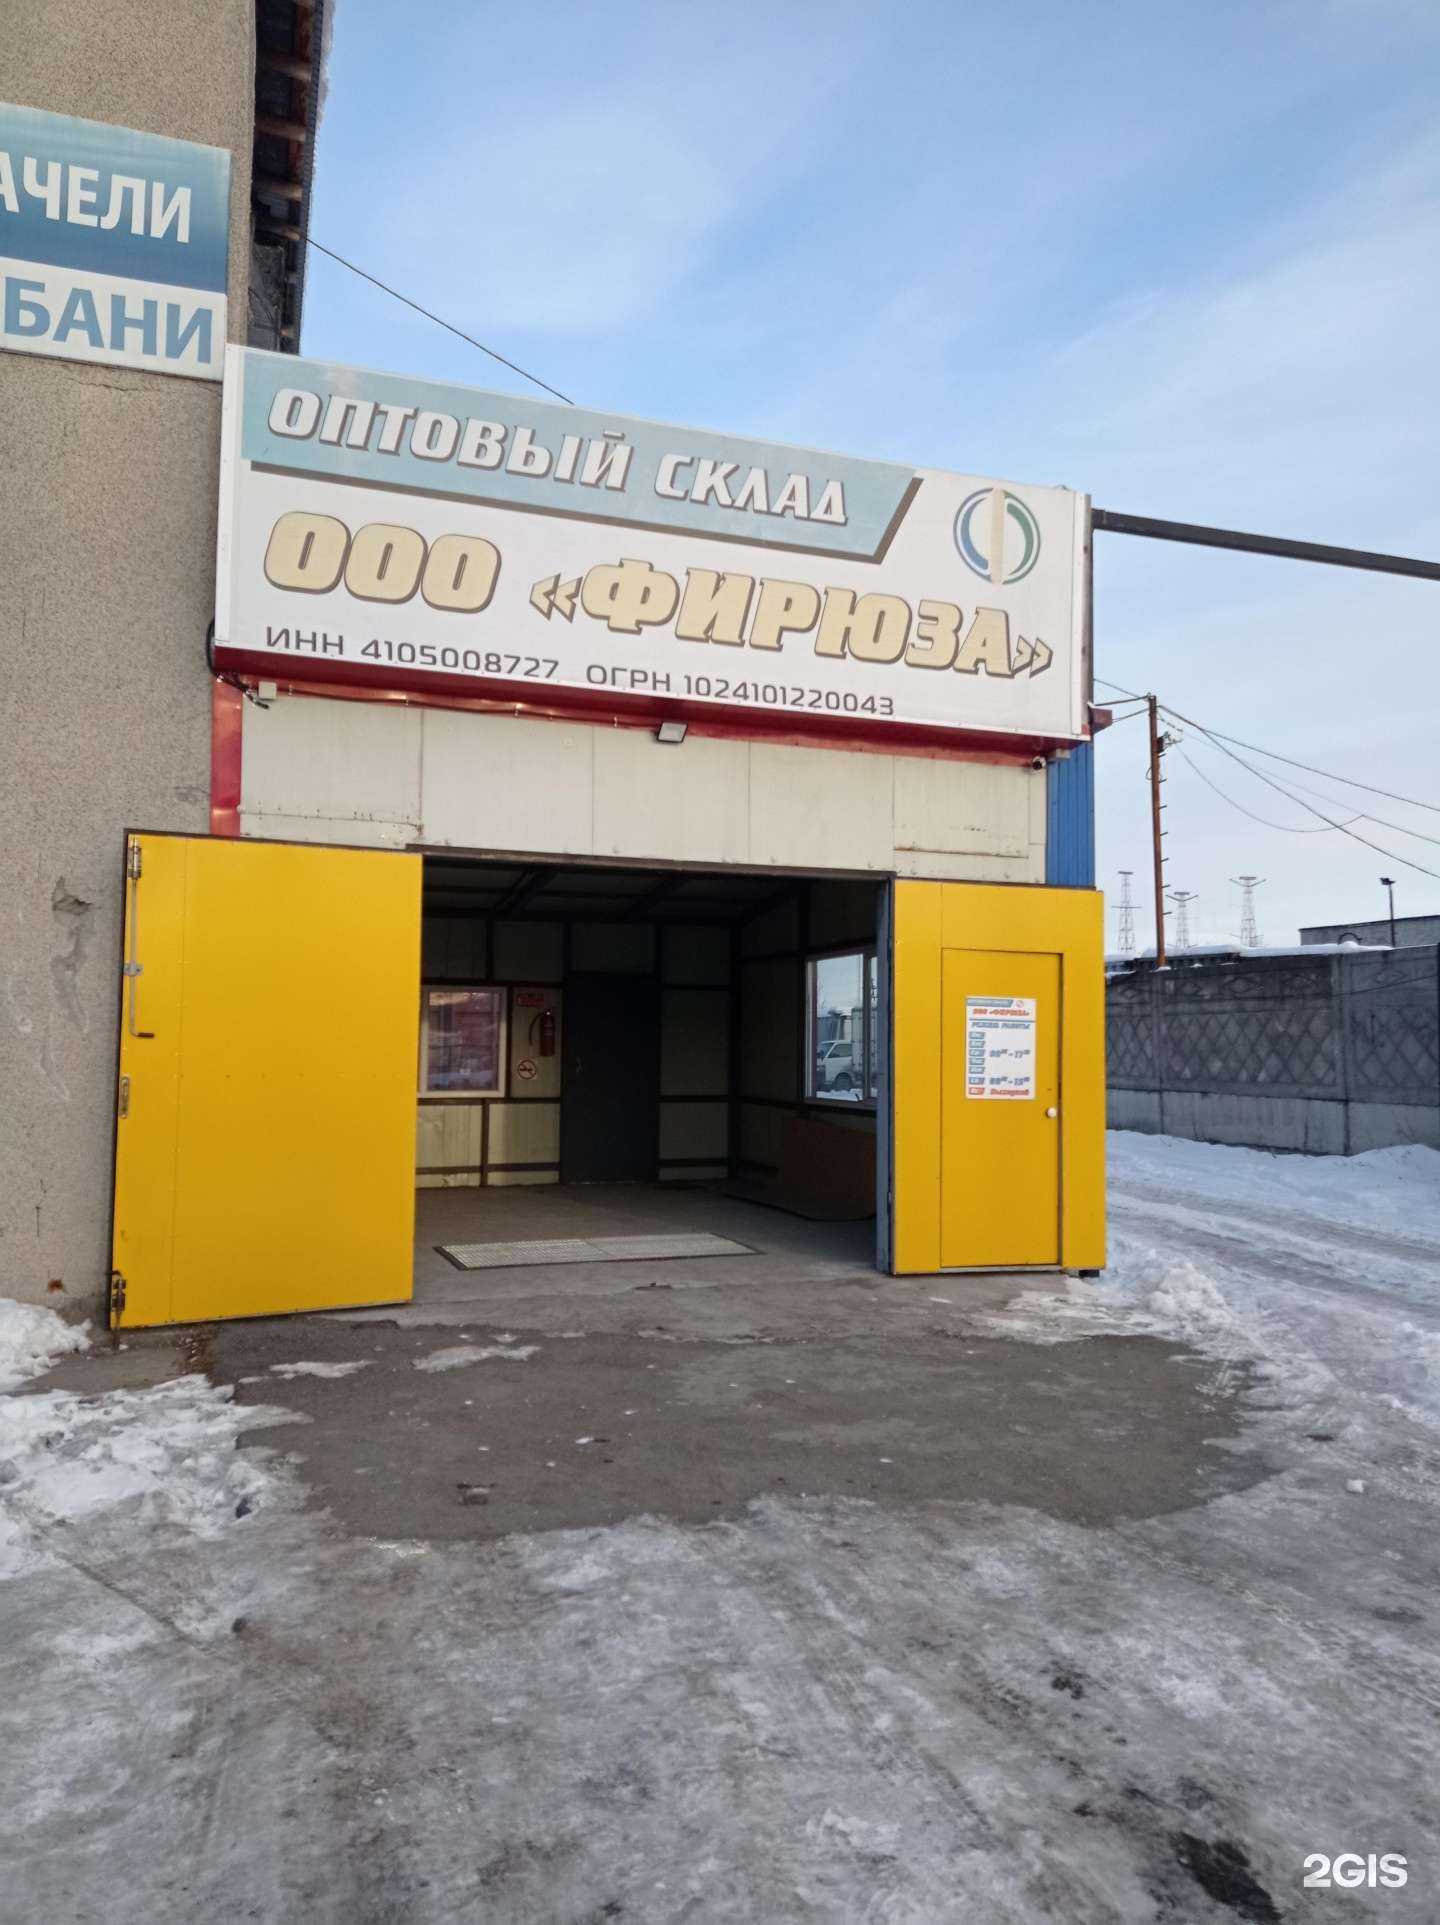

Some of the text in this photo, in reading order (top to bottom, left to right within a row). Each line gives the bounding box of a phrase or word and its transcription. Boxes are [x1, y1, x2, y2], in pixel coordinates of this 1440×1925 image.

[4, 276, 213, 364] БАНИ
[268, 387, 849, 526] ОПТОВЫЙ СКЛАД
[263, 511, 1054, 679] ООО «ФИРЮЗА»
[265, 626, 895, 717] ИНН 4105008727 ОГРН 1024101220043
